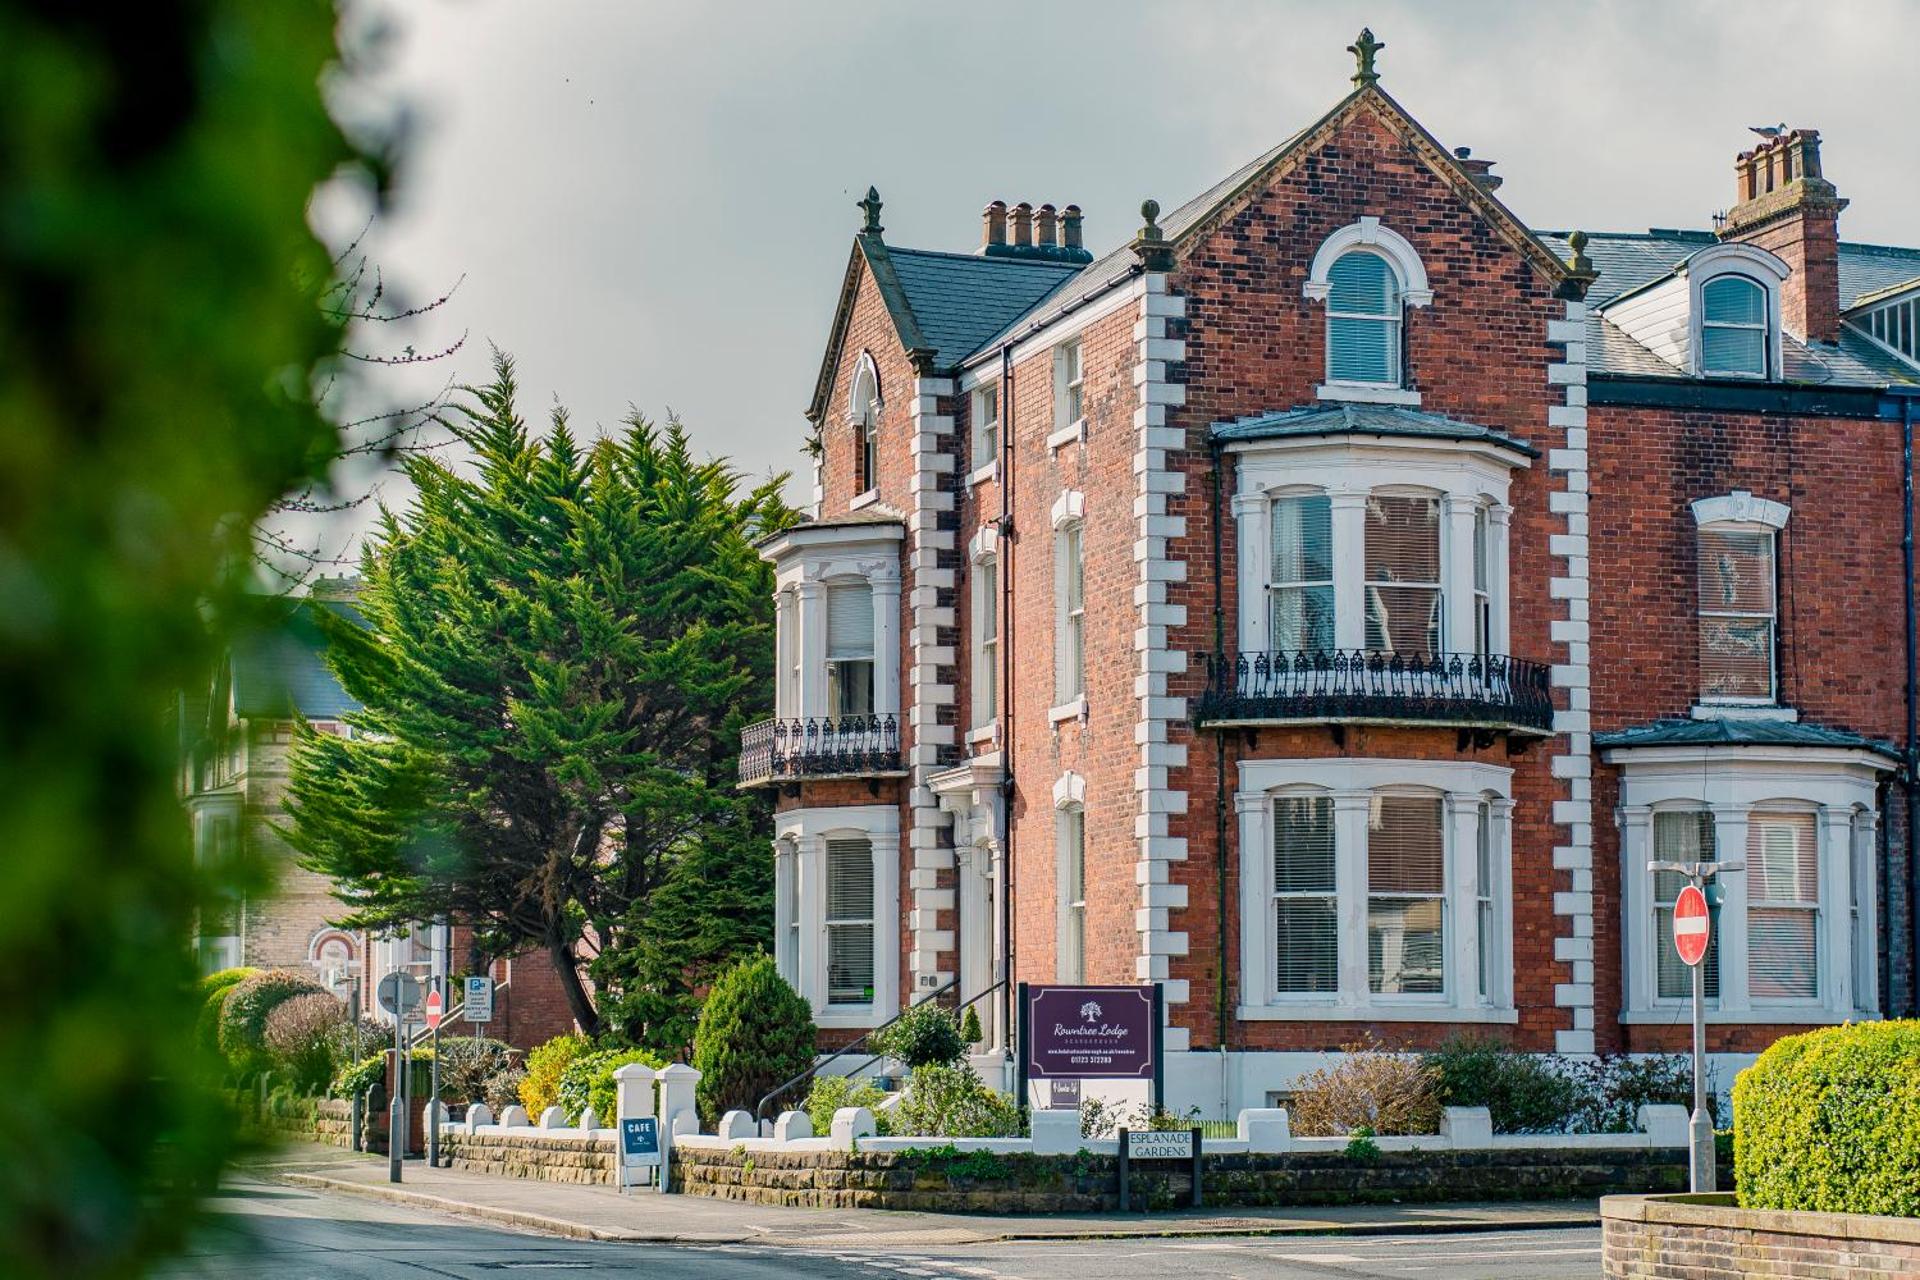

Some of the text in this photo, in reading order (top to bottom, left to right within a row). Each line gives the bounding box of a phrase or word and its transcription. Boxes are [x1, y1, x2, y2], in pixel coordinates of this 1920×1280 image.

[1054, 1023, 1129, 1039] Rowntree Lodge
[1130, 1133, 1190, 1144] ESPLANADE
[1135, 1146, 1186, 1157] GARDENS
